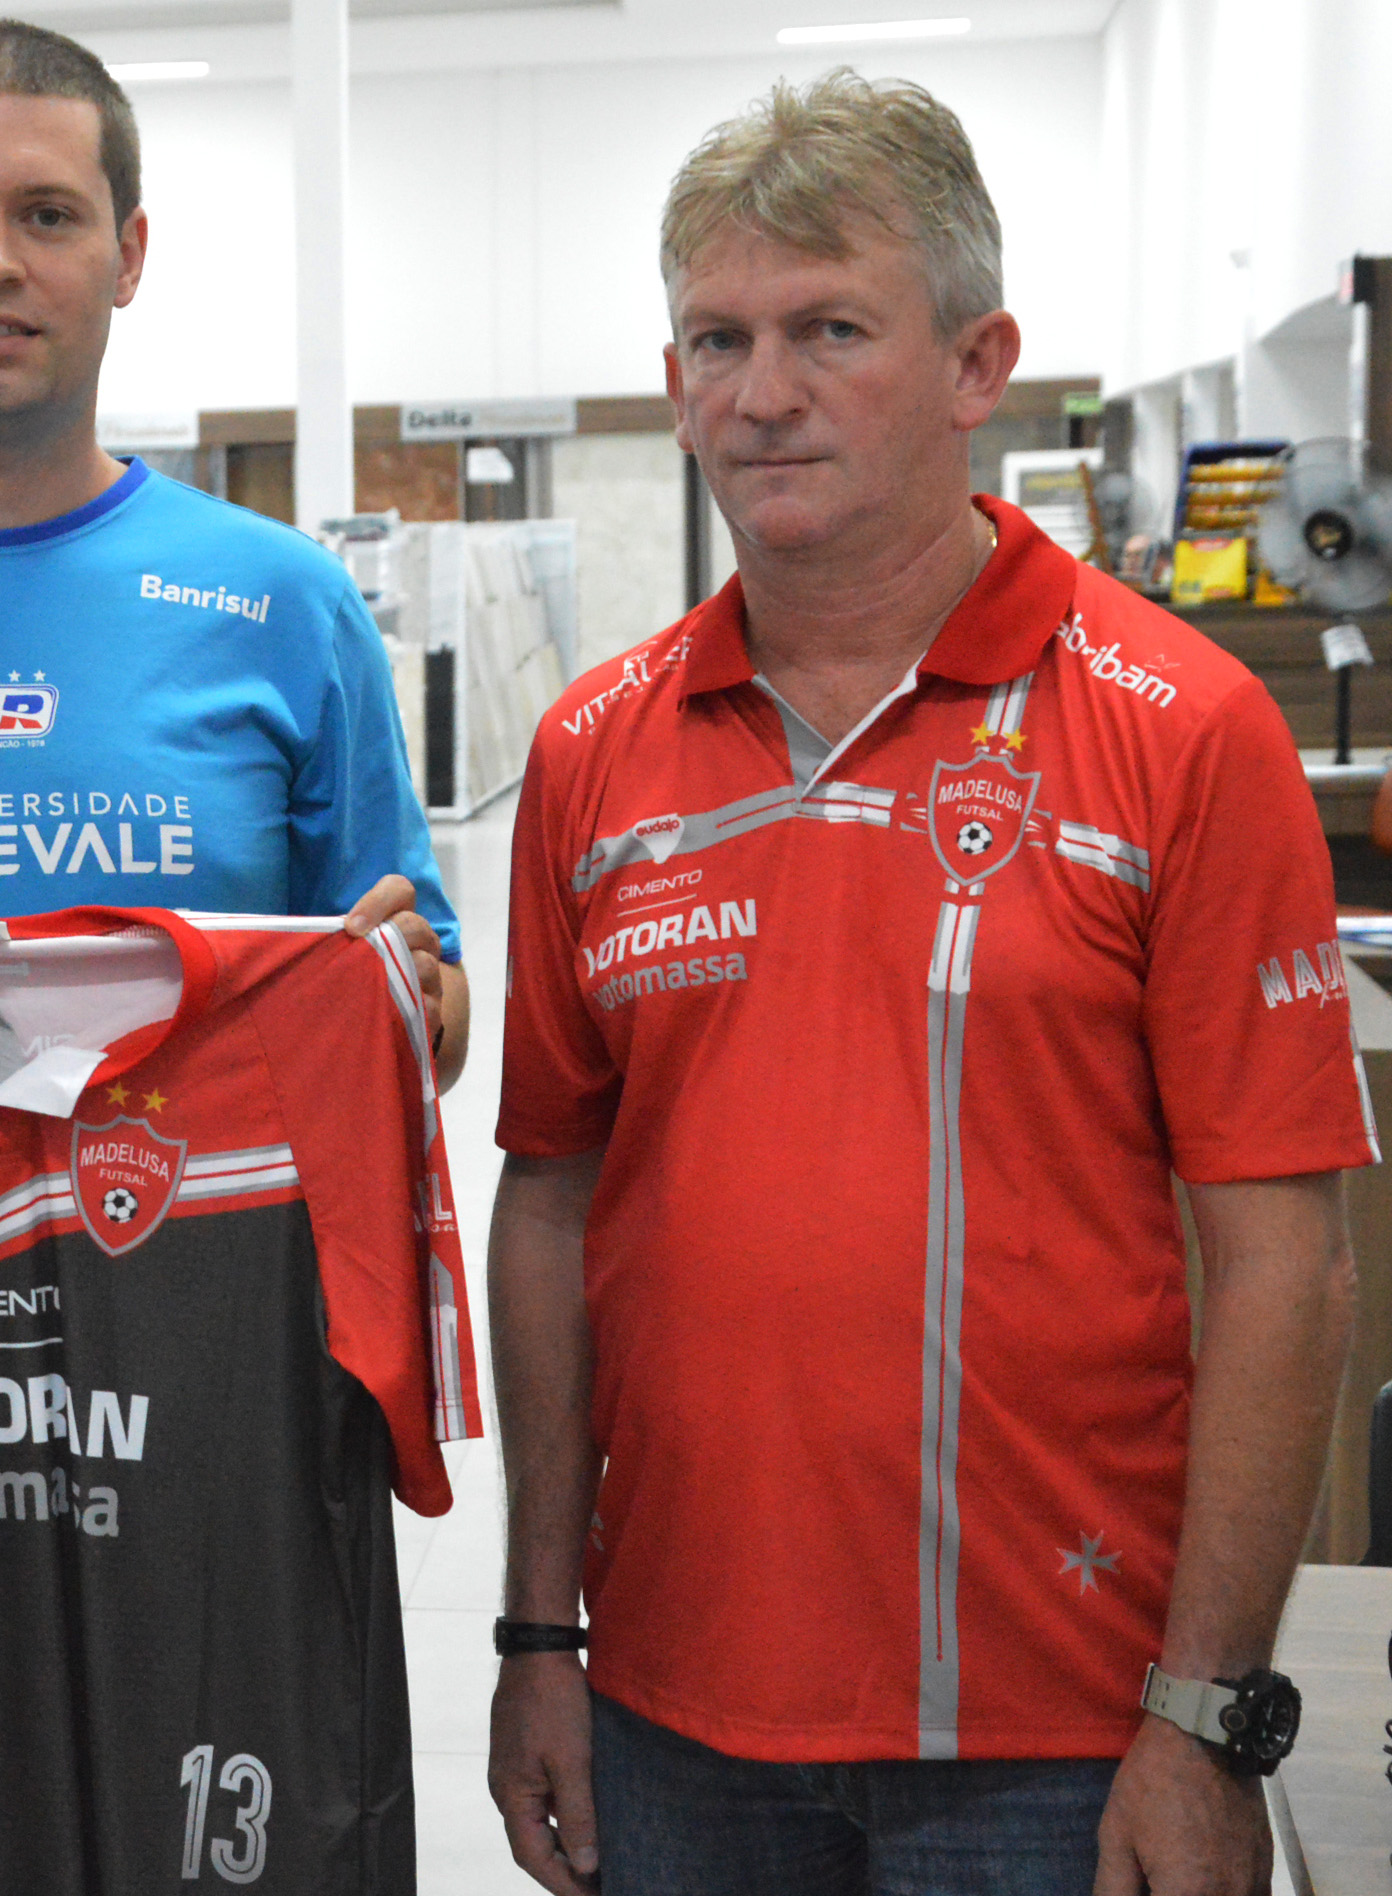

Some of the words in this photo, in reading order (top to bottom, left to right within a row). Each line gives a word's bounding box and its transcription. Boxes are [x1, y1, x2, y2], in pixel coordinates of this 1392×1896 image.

[140, 574, 271, 623] Banrisul
[938, 780, 1023, 813] MADELUSA
[956, 804, 1004, 821] FUTSAL
[618, 869, 702, 901] CIMENTO
[583, 899, 757, 978] VOTORAN
[593, 953, 747, 1013] votomassa
[80, 1143, 170, 1182] MADELUSA
[99, 1168, 147, 1187] FUTSAL
[180, 1744, 273, 1885] 13
